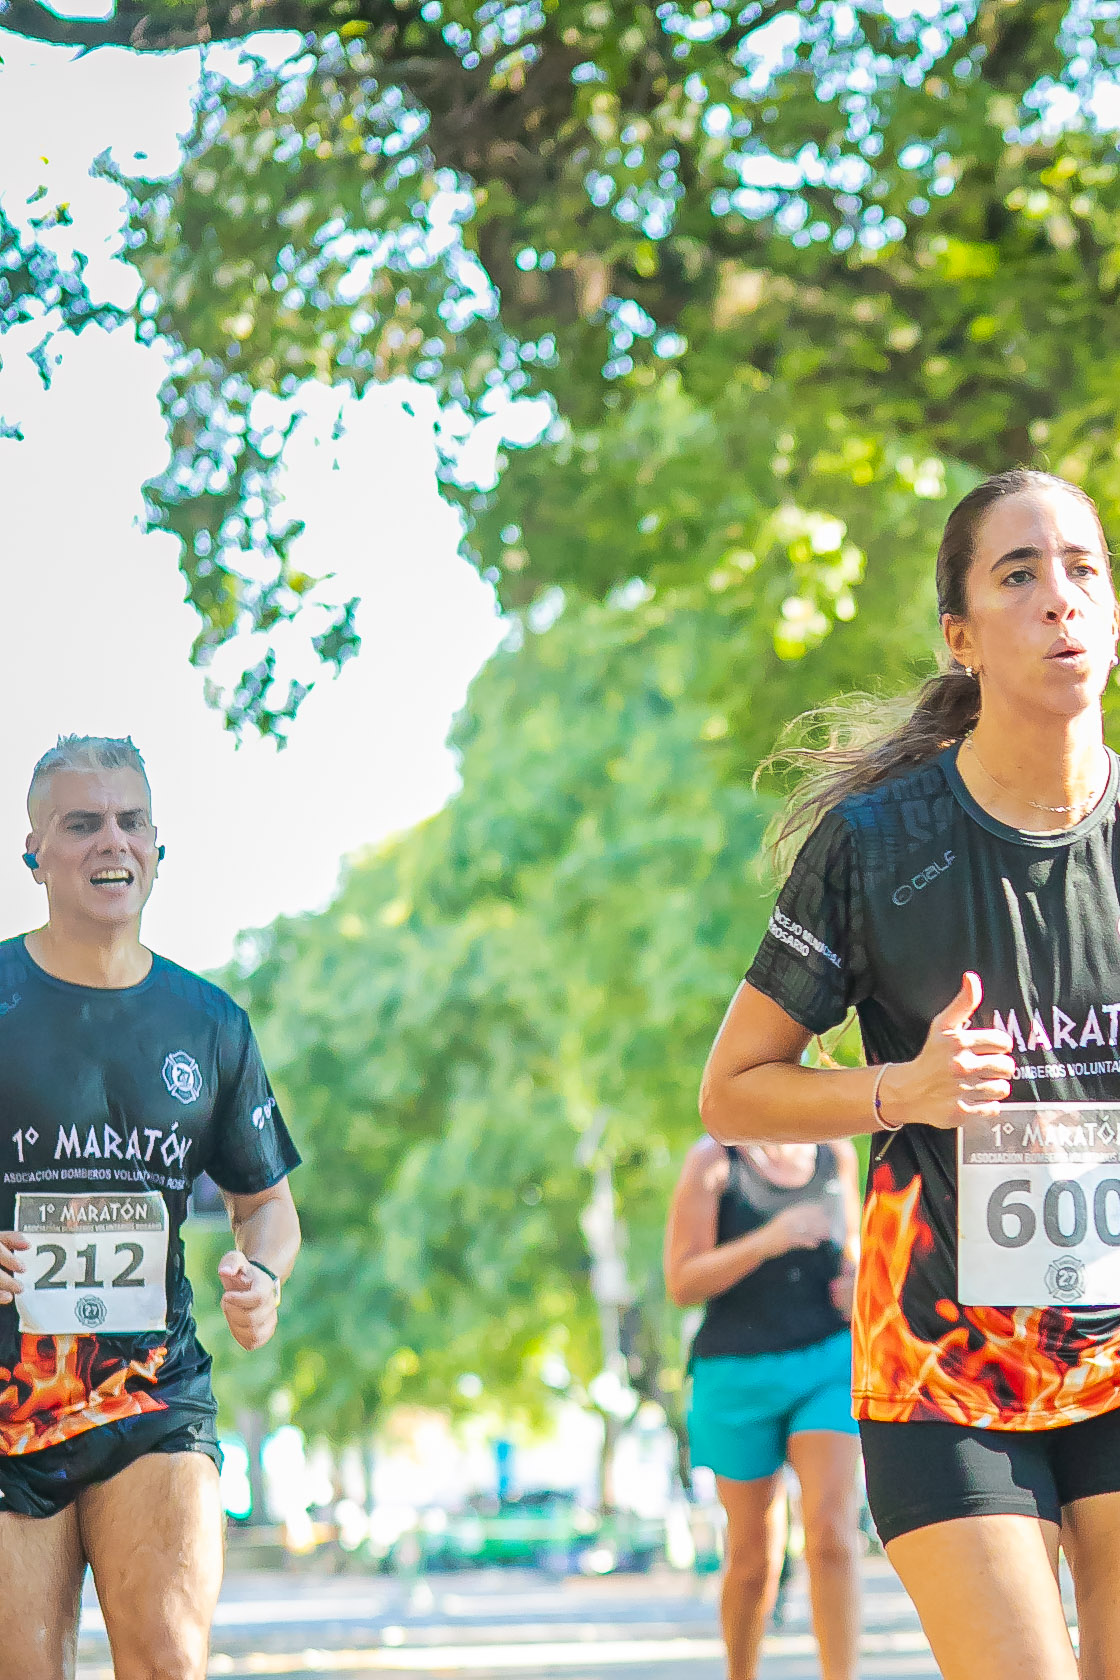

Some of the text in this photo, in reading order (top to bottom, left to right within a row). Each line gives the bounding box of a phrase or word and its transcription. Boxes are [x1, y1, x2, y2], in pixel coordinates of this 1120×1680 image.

[1013, 1063, 1067, 1080] OMBEROS
[54, 1121, 193, 1169] MARATÓN
[61, 1167, 112, 1180] BOMBEROS
[60, 1198, 148, 1223] MARATÓN
[34, 1242, 145, 1290] 212
